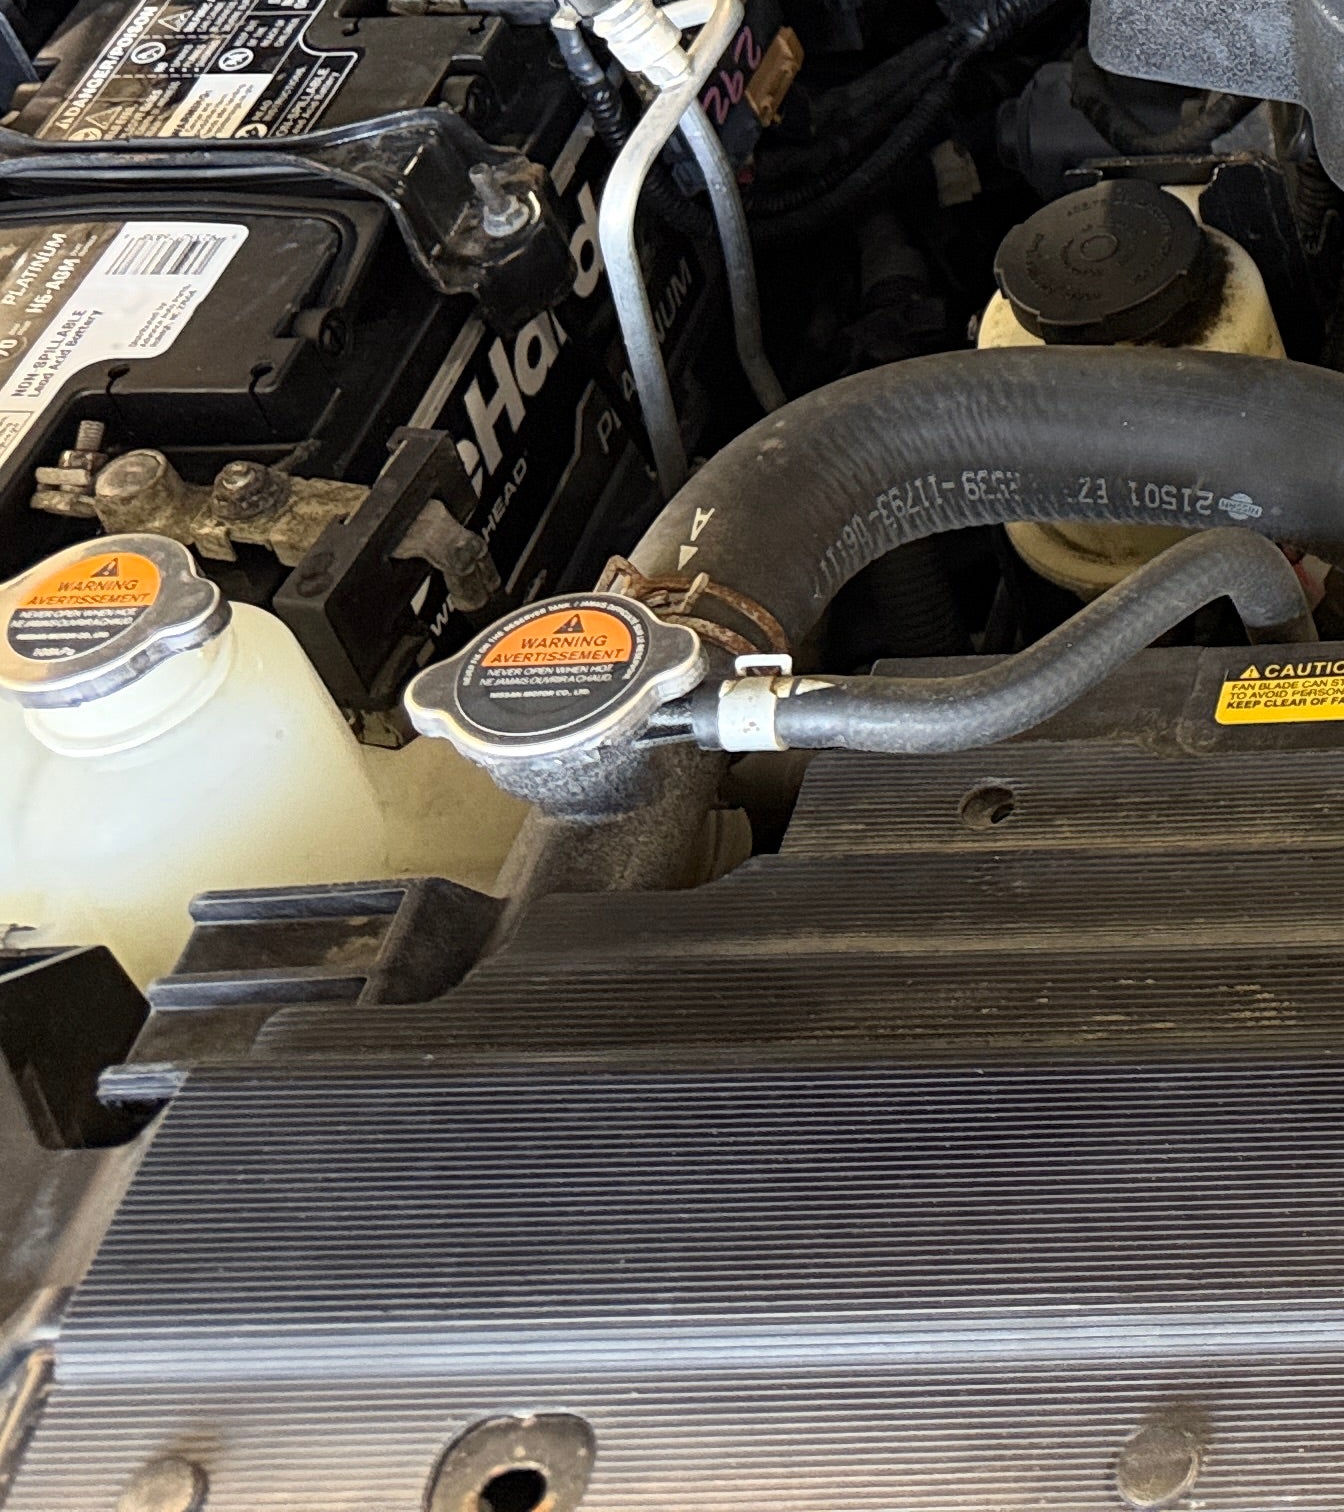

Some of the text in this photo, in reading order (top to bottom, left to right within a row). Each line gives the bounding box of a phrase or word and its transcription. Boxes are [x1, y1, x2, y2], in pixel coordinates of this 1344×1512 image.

[1, 233, 68, 305] PLATINUM
[65, 310, 104, 354] Battery
[11, 309, 87, 397] NON-SPILLABLE
[1127, 480, 1215, 515] 21501
[690, 506, 714, 542] A
[58, 579, 139, 592] WARNING
[27, 592, 151, 606] AVERTISSEMENT
[521, 635, 608, 649] WARNING
[490, 648, 625, 663] AVERTISSEMENT
[487, 668, 522, 677] NEVER
[523, 666, 554, 676] OPEN
[1231, 681, 1256, 692] FAN
[1258, 680, 1299, 691] BLADE
[1301, 679, 1329, 689] CAN
[1229, 691, 1247, 700] TO
[1248, 690, 1287, 700] AVOID
[1226, 700, 1262, 710] KEEP
[1263, 698, 1308, 708] CLEAR
[1309, 696, 1328, 706] OF
